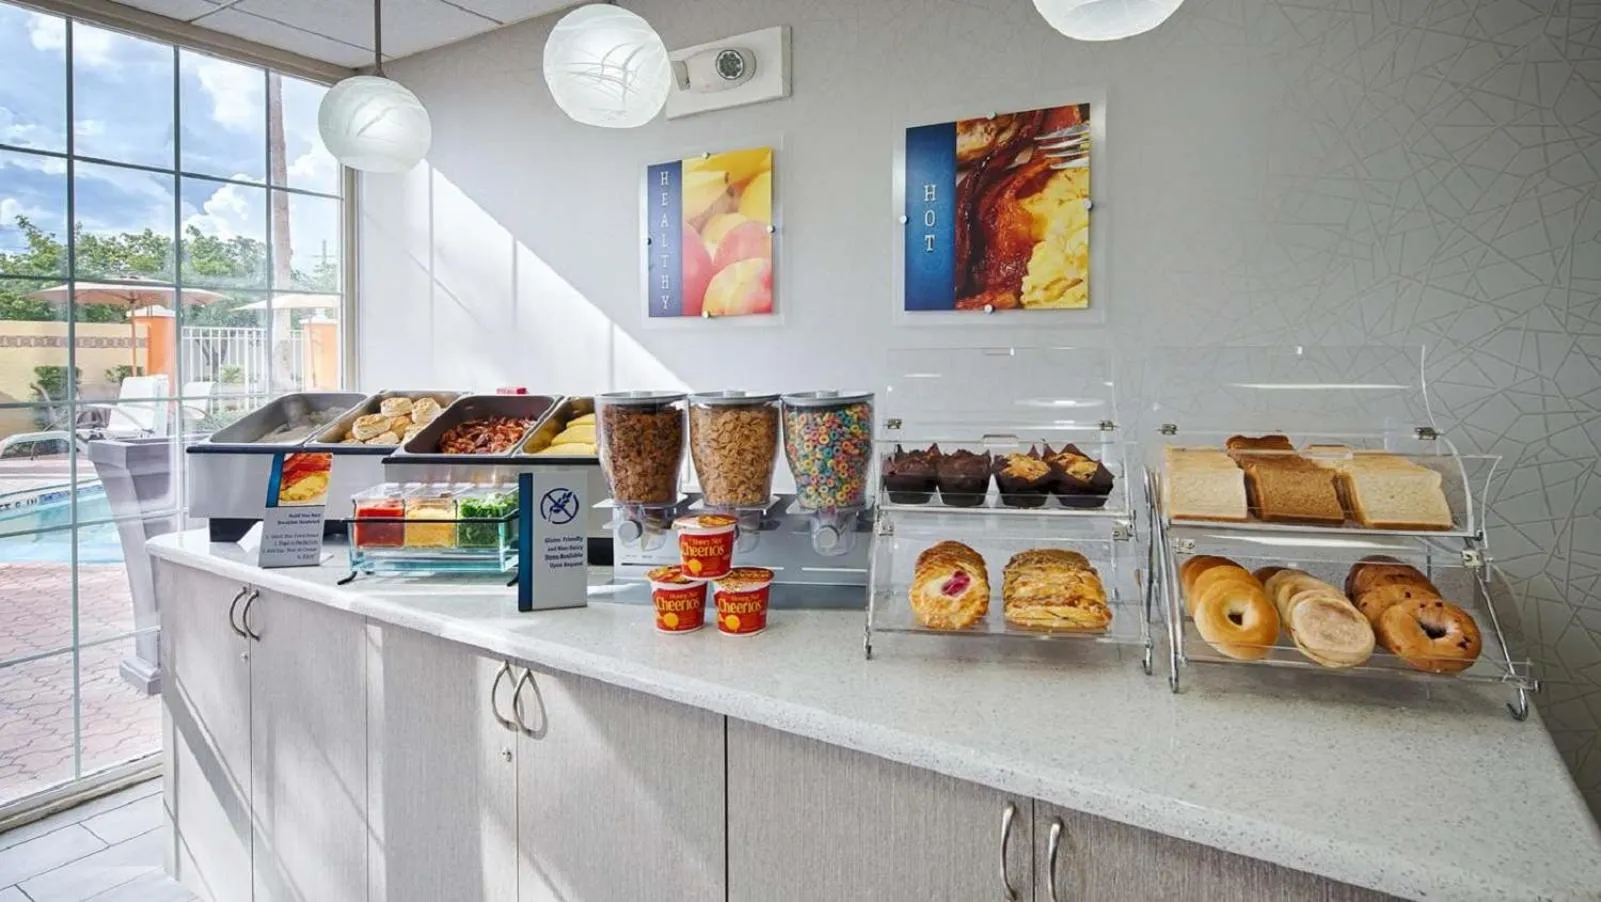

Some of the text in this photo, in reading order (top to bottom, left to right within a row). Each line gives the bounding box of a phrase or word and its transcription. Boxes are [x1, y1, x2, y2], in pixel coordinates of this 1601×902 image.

[924, 184, 936, 252] HOT
[660, 171, 669, 310] HEALTHY
[681, 541, 725, 557] Cheerios
[656, 596, 700, 612] Cheerios
[718, 598, 762, 614] Cheerios
